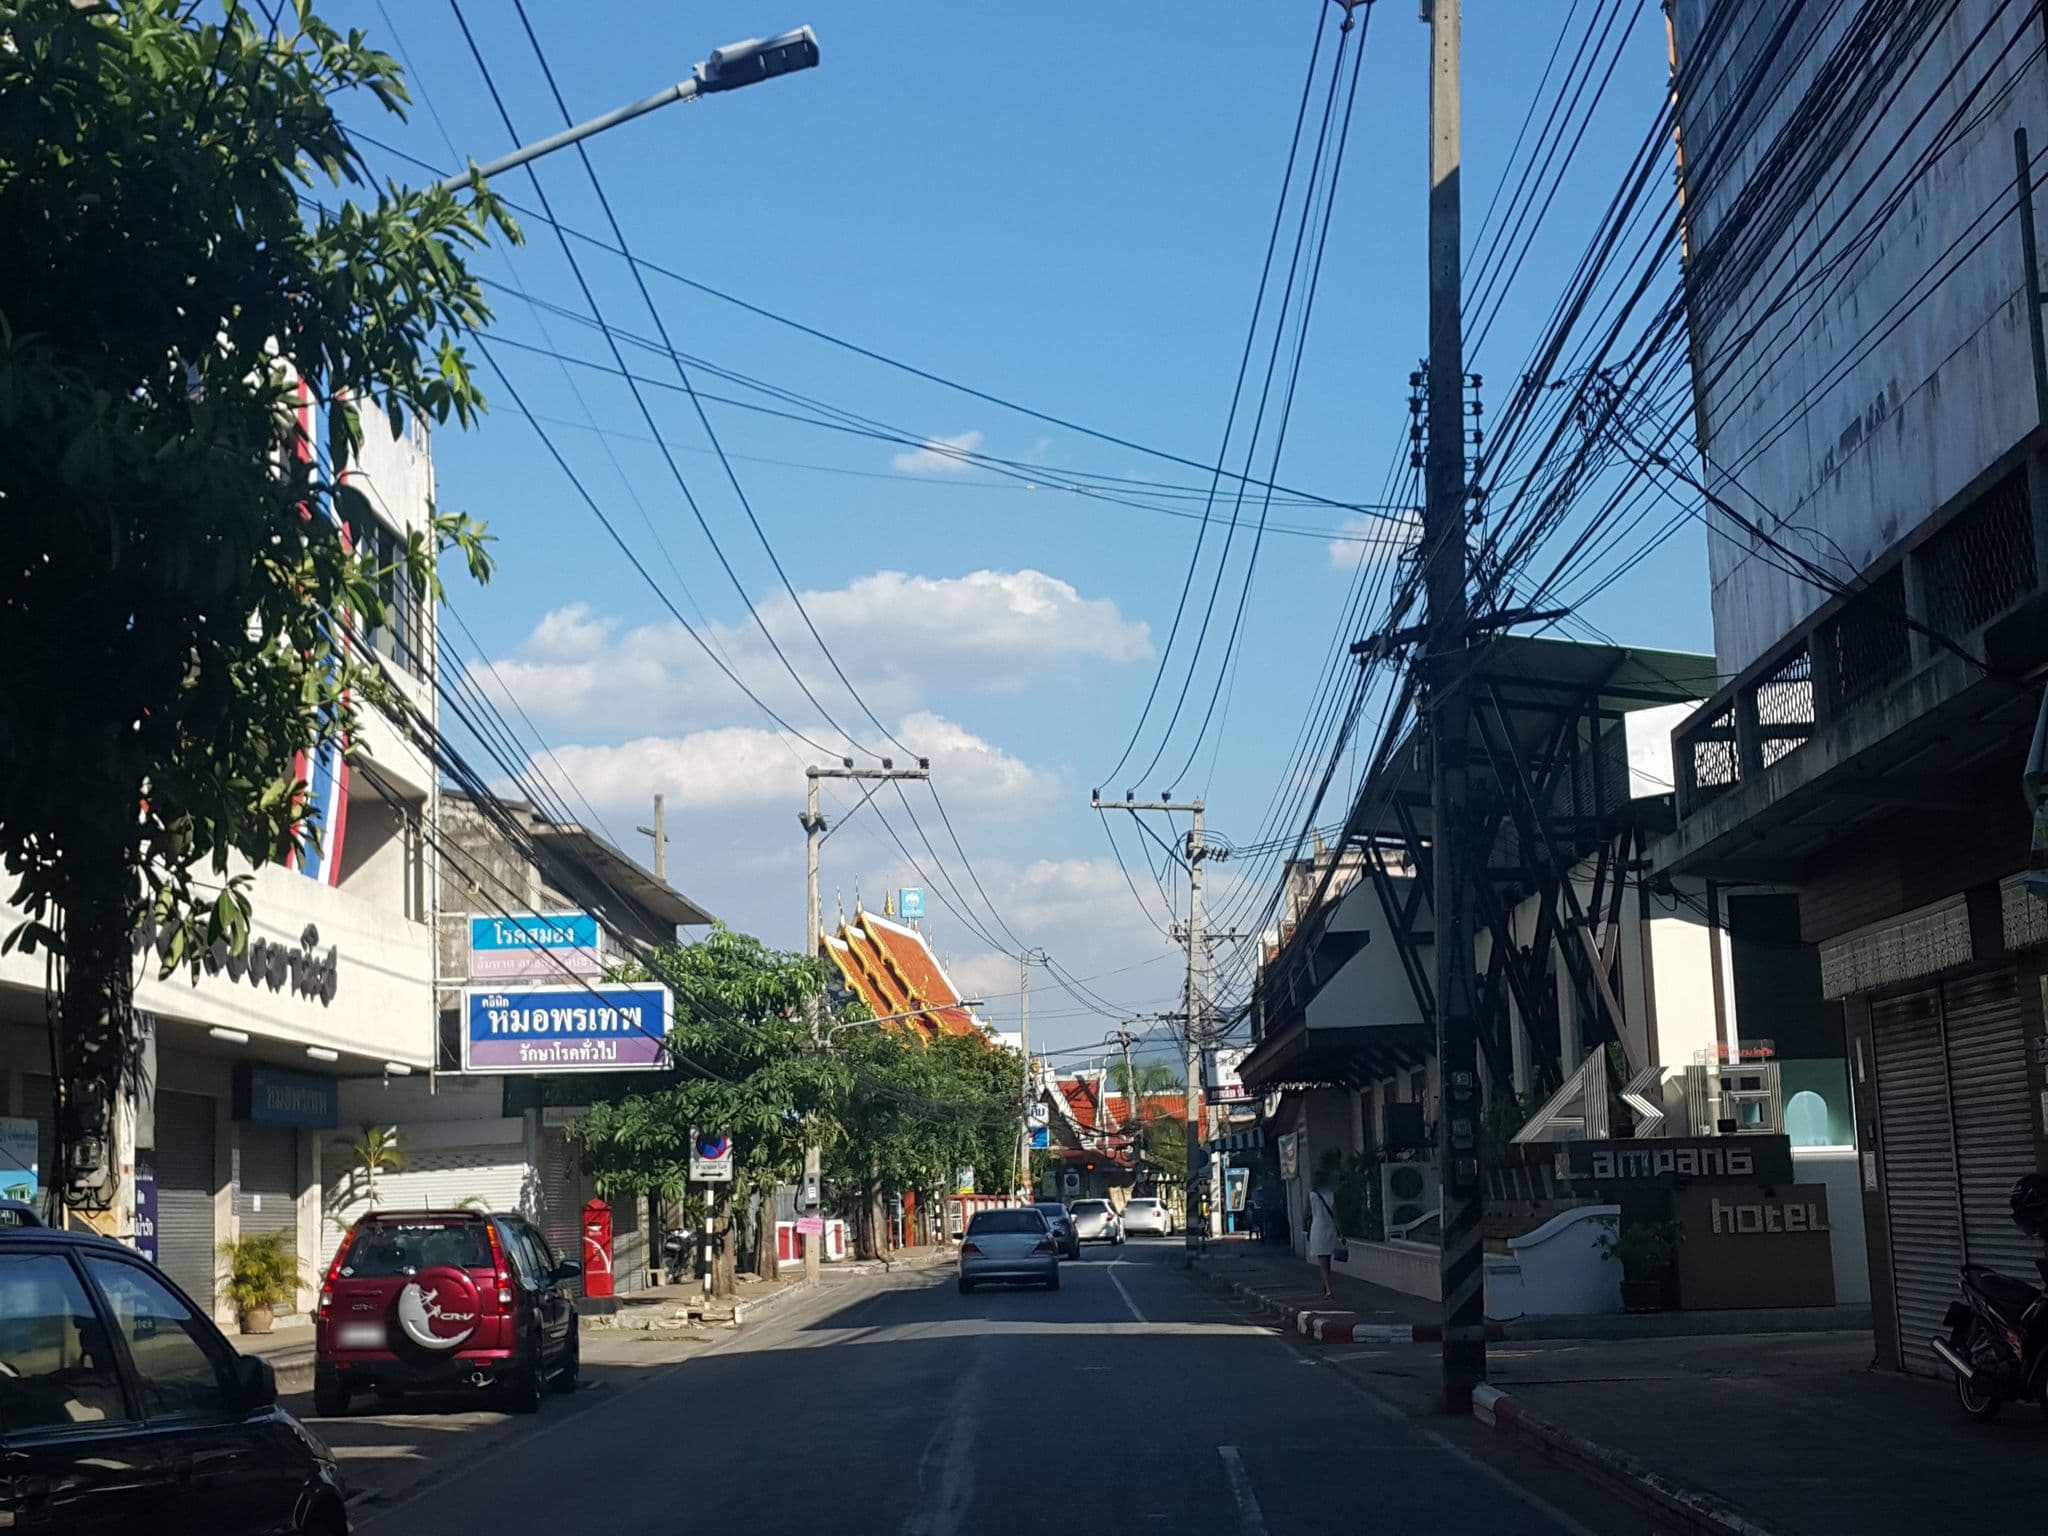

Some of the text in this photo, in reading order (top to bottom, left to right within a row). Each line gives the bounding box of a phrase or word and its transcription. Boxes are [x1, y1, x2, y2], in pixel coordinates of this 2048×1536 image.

[493, 920, 574, 945] โรคสมอง
[488, 1007, 642, 1033] หมอพรเทพ
[519, 1038, 617, 1062] รักษาโรคทั่วไป
[440, 1312, 475, 1320] CR-V
